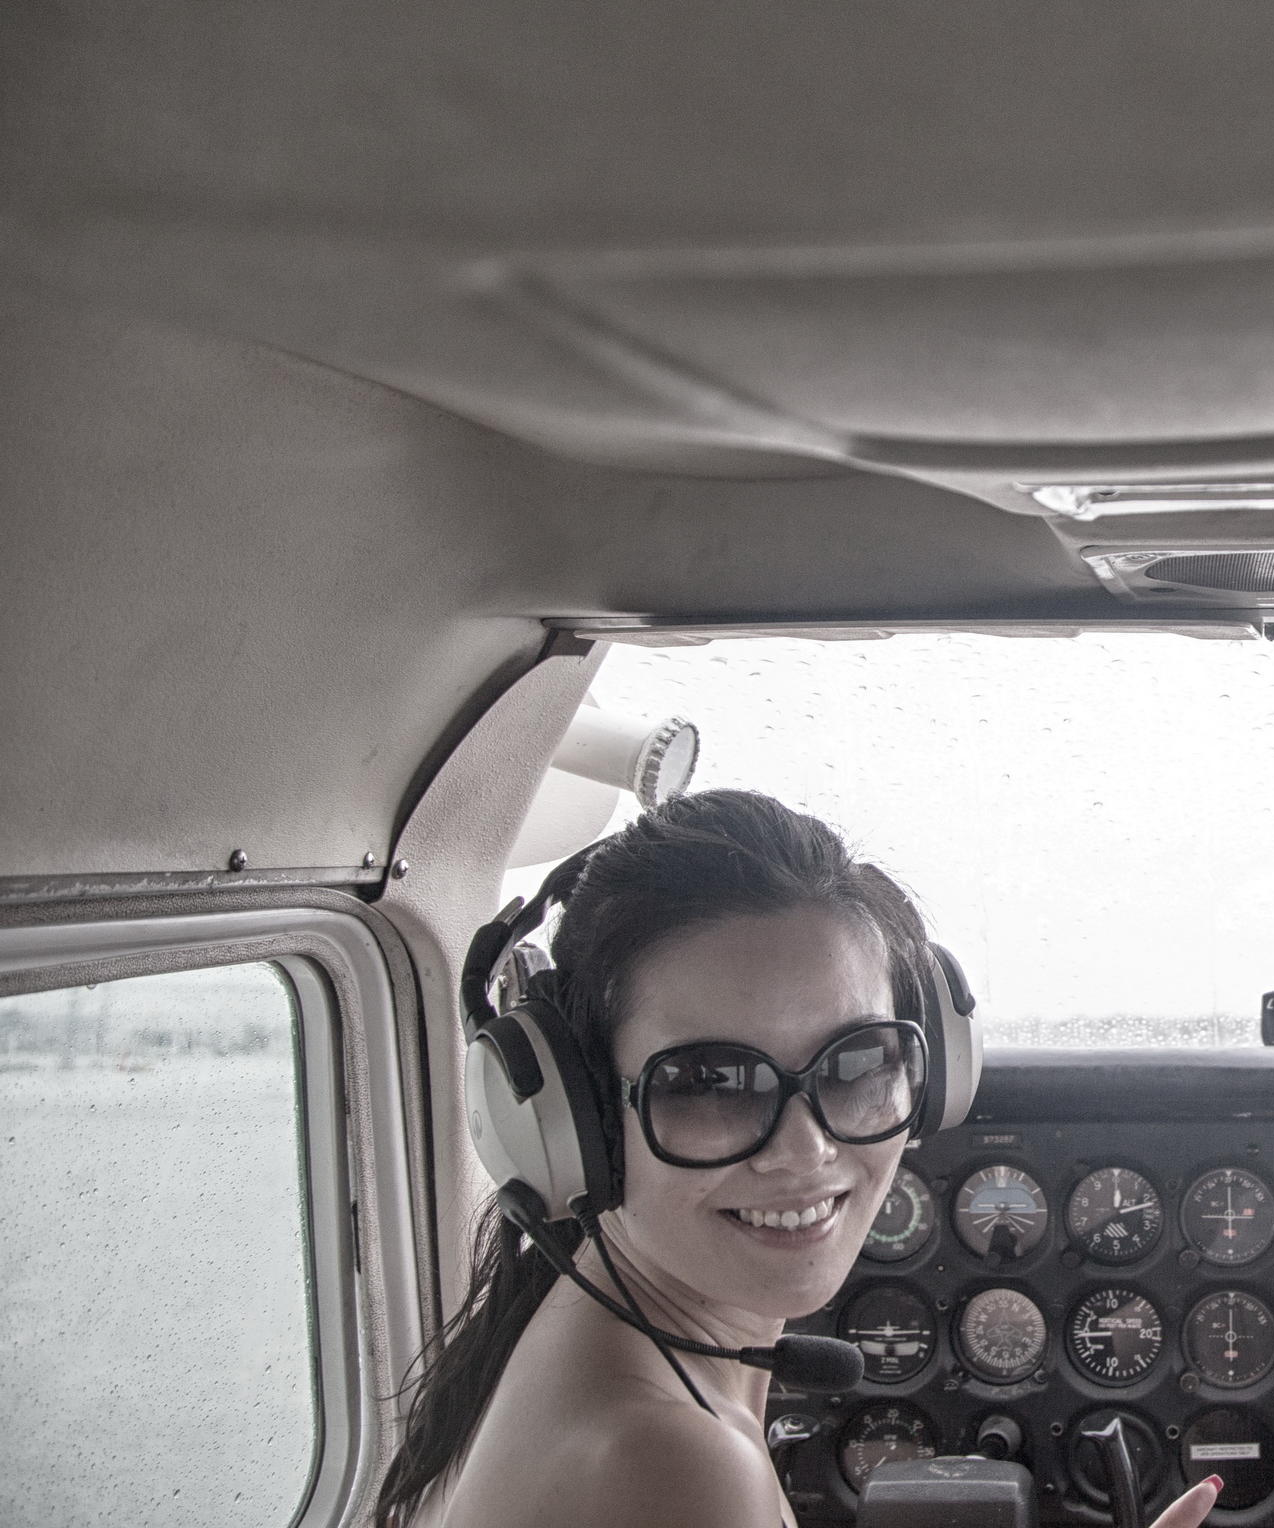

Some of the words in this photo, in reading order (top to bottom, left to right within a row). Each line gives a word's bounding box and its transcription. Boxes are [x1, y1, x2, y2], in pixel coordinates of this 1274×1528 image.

[1094, 1181, 1101, 1190] 9
[1082, 1197, 1089, 1207] 8
[1143, 1194, 1150, 1202] 2
[1080, 1217, 1088, 1226] 7
[1143, 1220, 1151, 1230] 3
[1093, 1233, 1101, 1243] 6
[1132, 1234, 1140, 1243] 4
[1112, 1240, 1120, 1250] 5
[1106, 1299, 1118, 1309] 10
[1139, 1328, 1152, 1338] 20
[1106, 1357, 1119, 1367] 10
[855, 1466, 861, 1475] 5
